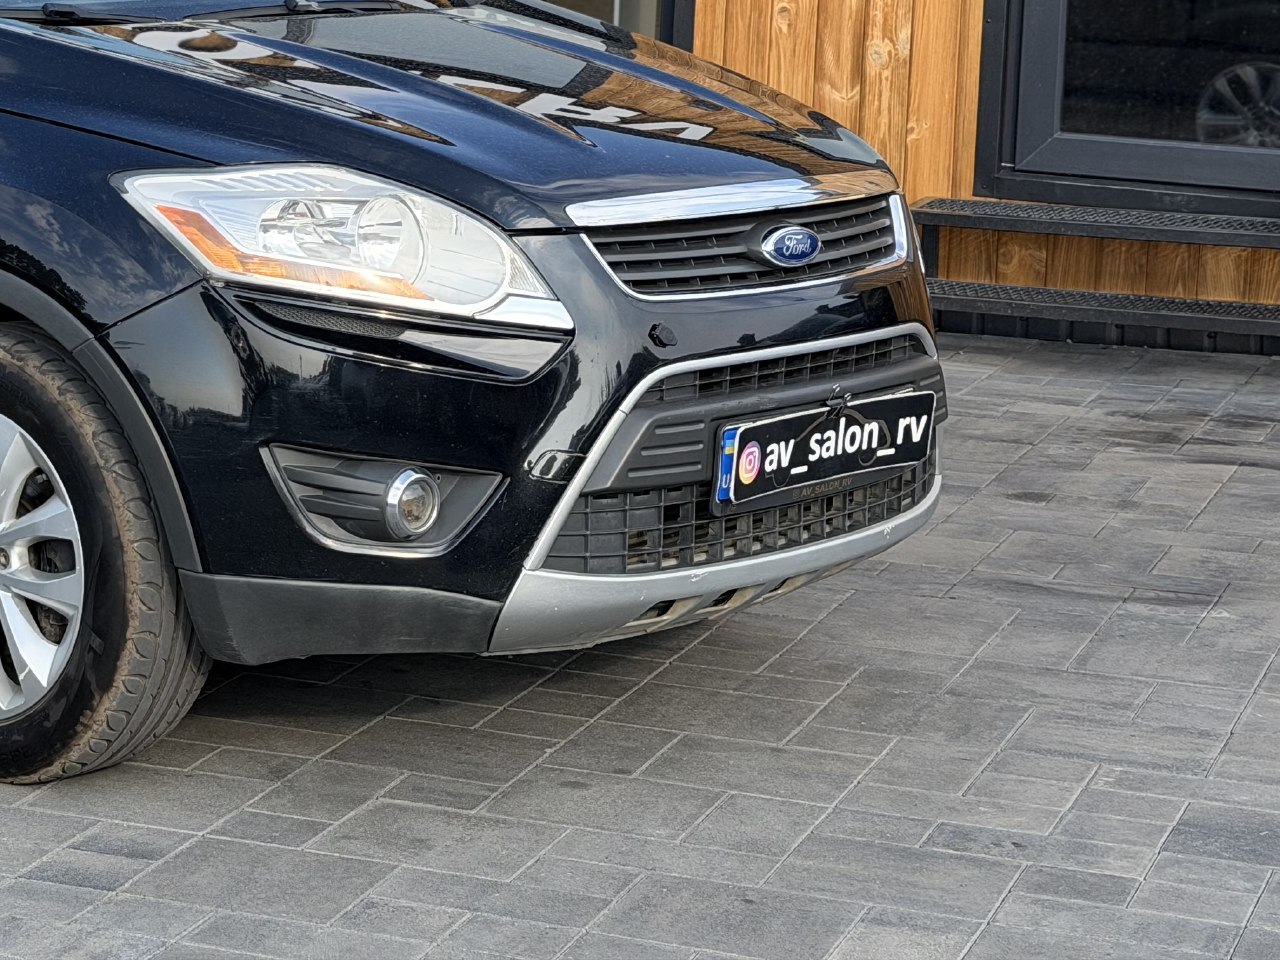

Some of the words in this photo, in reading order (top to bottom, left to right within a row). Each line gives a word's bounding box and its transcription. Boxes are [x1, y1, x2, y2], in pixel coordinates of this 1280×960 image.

[783, 234, 812, 256] Ford
[765, 414, 928, 475] av_salon_rv
[720, 474, 733, 489] U
[800, 477, 854, 497] AV_SALON_RV
